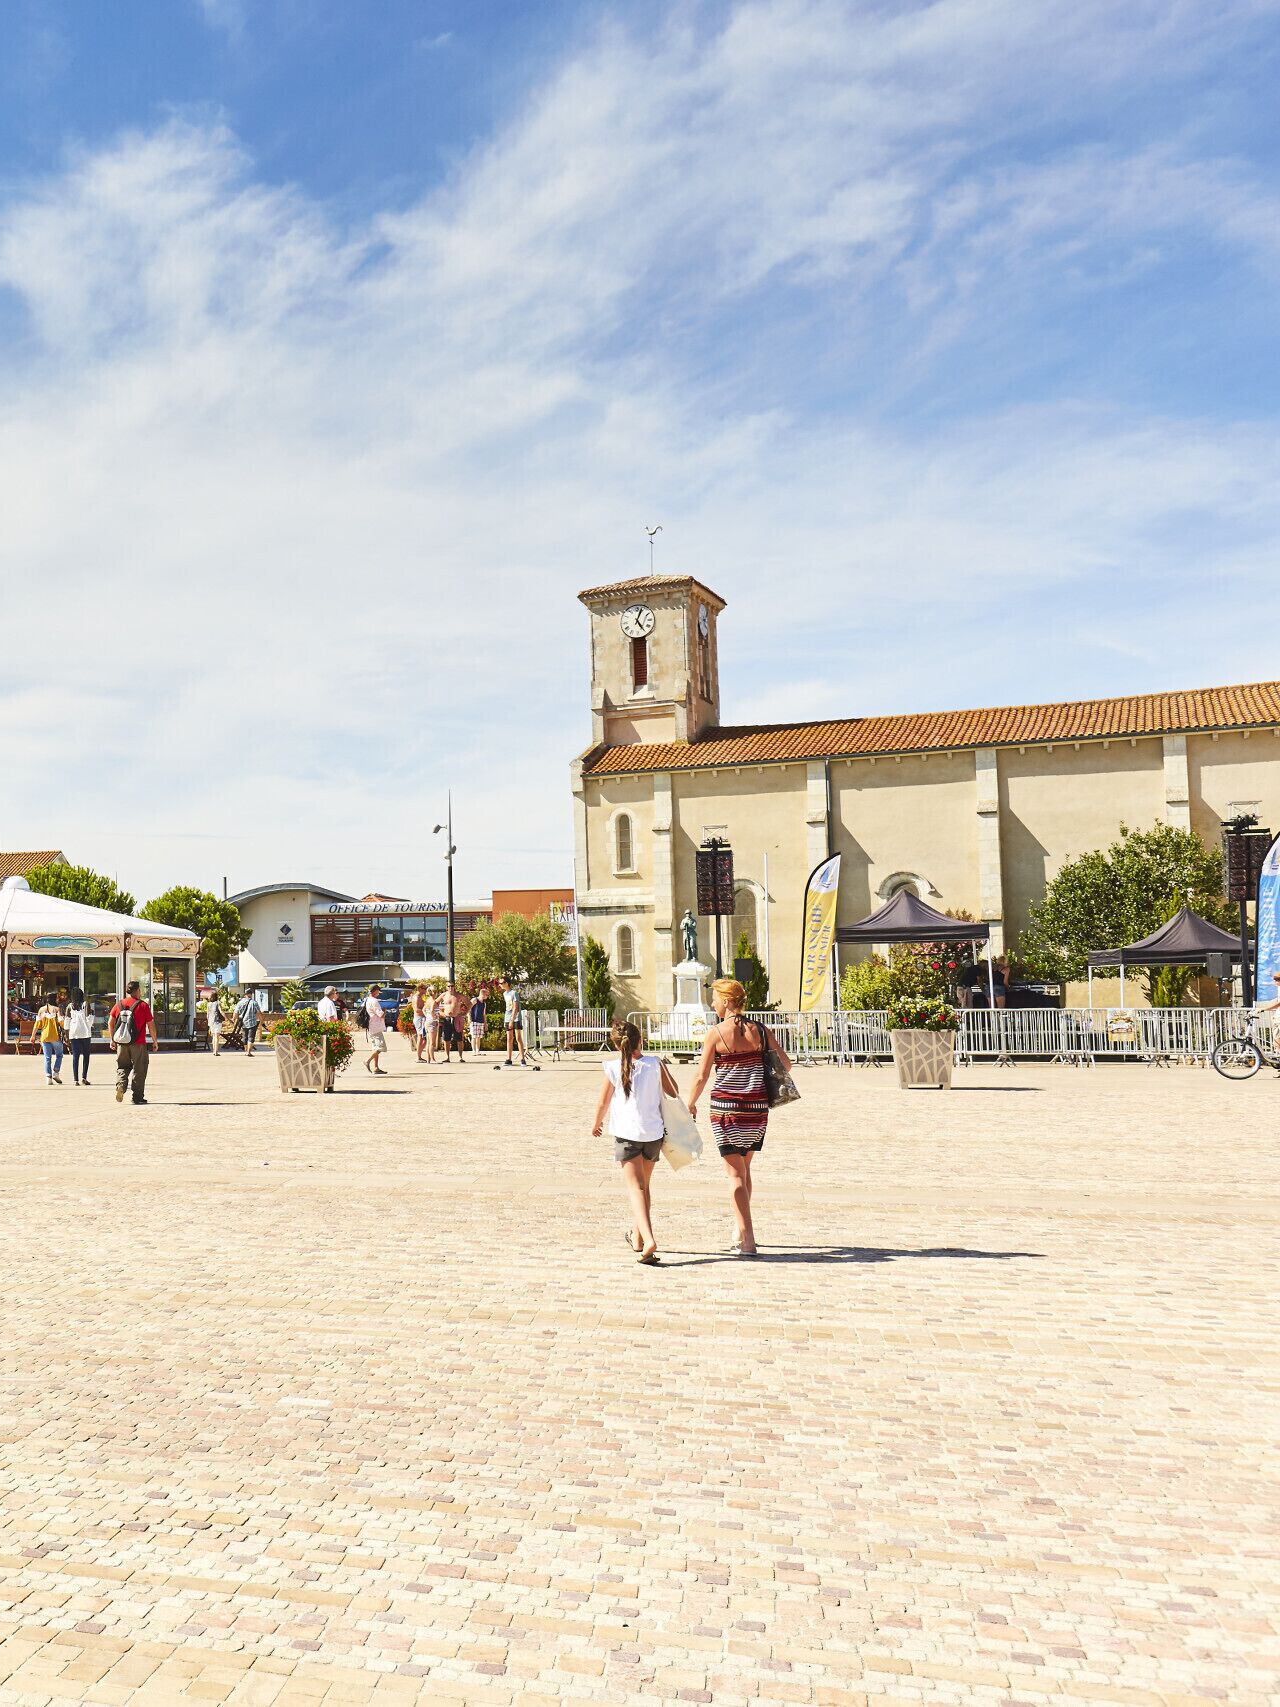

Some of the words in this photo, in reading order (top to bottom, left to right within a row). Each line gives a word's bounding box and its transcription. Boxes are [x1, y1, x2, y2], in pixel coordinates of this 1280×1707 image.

[329, 903, 369, 913] OFFICE
[372, 903, 389, 912] DE
[552, 905, 575, 922] EXP
[817, 954, 827, 977] SUR
